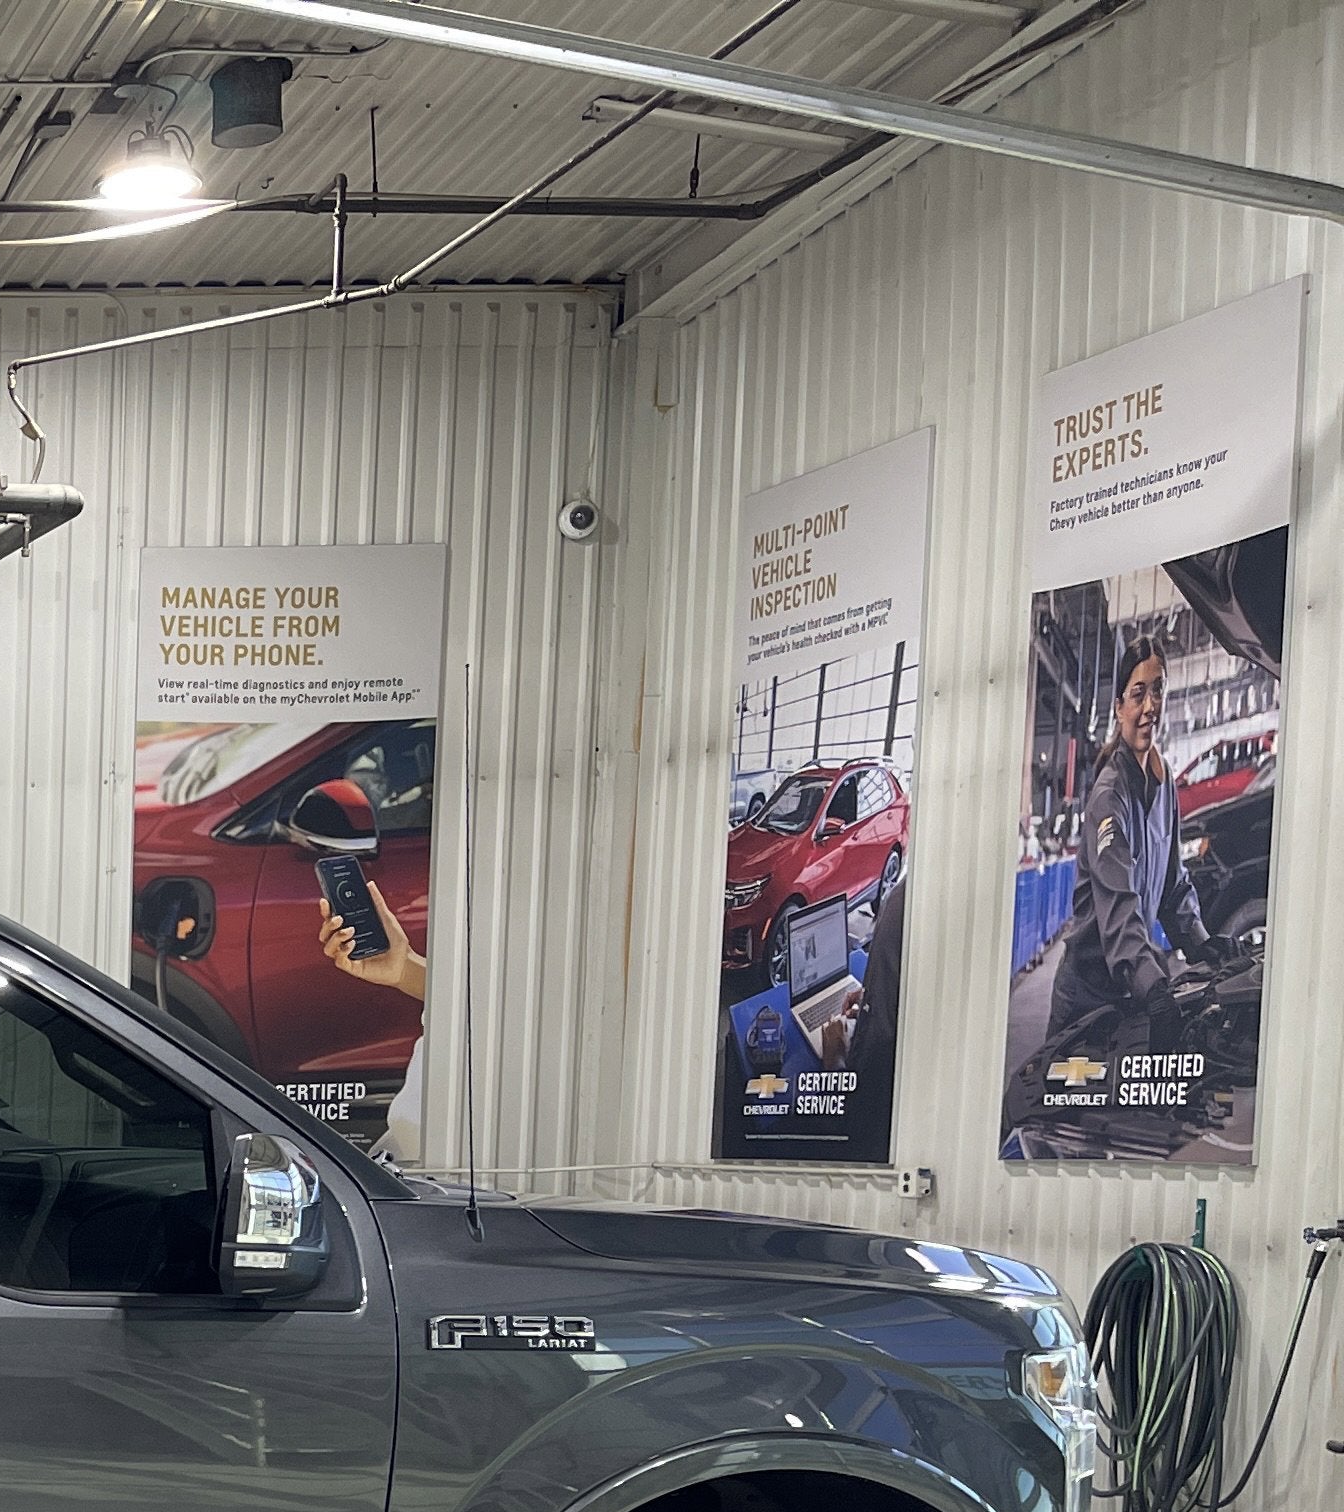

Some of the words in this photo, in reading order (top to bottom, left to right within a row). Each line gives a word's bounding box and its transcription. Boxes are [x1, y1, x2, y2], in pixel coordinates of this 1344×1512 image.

[1054, 400, 1117, 446] TRUST
[1123, 383, 1163, 424] THE
[1052, 429, 1149, 483] EXPERTS.
[1050, 495, 1084, 514] Factory
[1086, 482, 1118, 504] trained
[1120, 467, 1174, 493] technicians
[1176, 456, 1202, 476] know
[1204, 449, 1228, 471] your
[1049, 515, 1077, 532] Chevy
[1078, 505, 1110, 525] vehicle
[1111, 497, 1140, 515] better
[1142, 489, 1164, 506] than
[1166, 478, 1204, 499] anyone.
[753, 504, 850, 559] MULTI-POINT
[752, 548, 813, 590] VEHICLE
[161, 586, 266, 610] MANAGE
[274, 586, 339, 609] YOUR
[750, 572, 837, 621] INSPECTION
[160, 615, 265, 638] VEHICLE
[273, 615, 340, 638] FROM
[160, 643, 225, 666] YOUR
[233, 643, 324, 666] PHONE.
[157, 677, 185, 689] View
[187, 678, 239, 690] real-time
[242, 678, 305, 692] diagnostics
[308, 679, 328, 690] and
[331, 678, 360, 691] enjoy
[363, 677, 404, 688] remote
[191, 693, 240, 705] available
[242, 694, 256, 704] on
[259, 693, 277, 704] the
[280, 691, 350, 706] myChevrolet
[353, 691, 389, 704] Mobile
[1121, 1053, 1204, 1078] CERTIFIED
[798, 1072, 858, 1092] CERTIFIED
[1118, 1082, 1188, 1106] SERVICE
[743, 1104, 790, 1115] CHEVROLET
[796, 1095, 846, 1115] SERVICE
[1043, 1093, 1109, 1106] CHEVROLET
[527, 1338, 588, 1349] LARIAT
